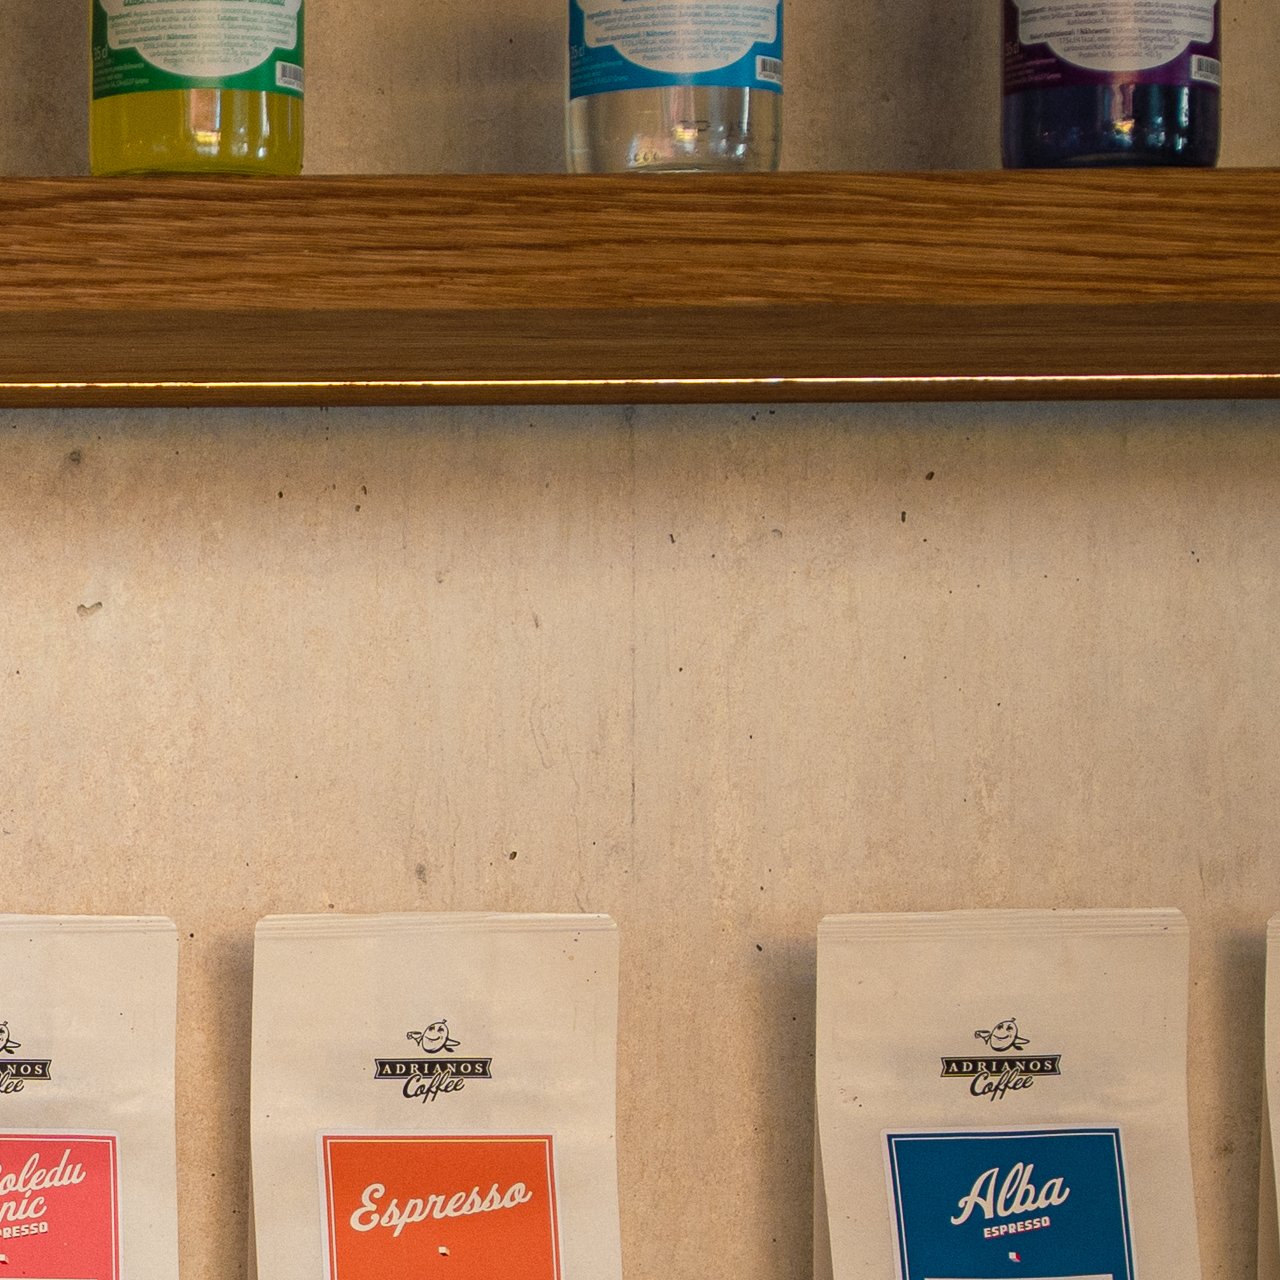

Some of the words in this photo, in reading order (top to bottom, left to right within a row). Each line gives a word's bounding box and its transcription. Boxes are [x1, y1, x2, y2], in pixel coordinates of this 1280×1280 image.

[383, 1063, 483, 1074] ADRIANOS
[949, 1060, 1053, 1072] ADRIANOS
[403, 1070, 465, 1103] Coffee
[970, 1068, 1034, 1101] Coffee
[350, 1182, 533, 1237] Espresso
[950, 1162, 1070, 1225] Alba
[983, 1216, 1051, 1239] ESPRESSO
